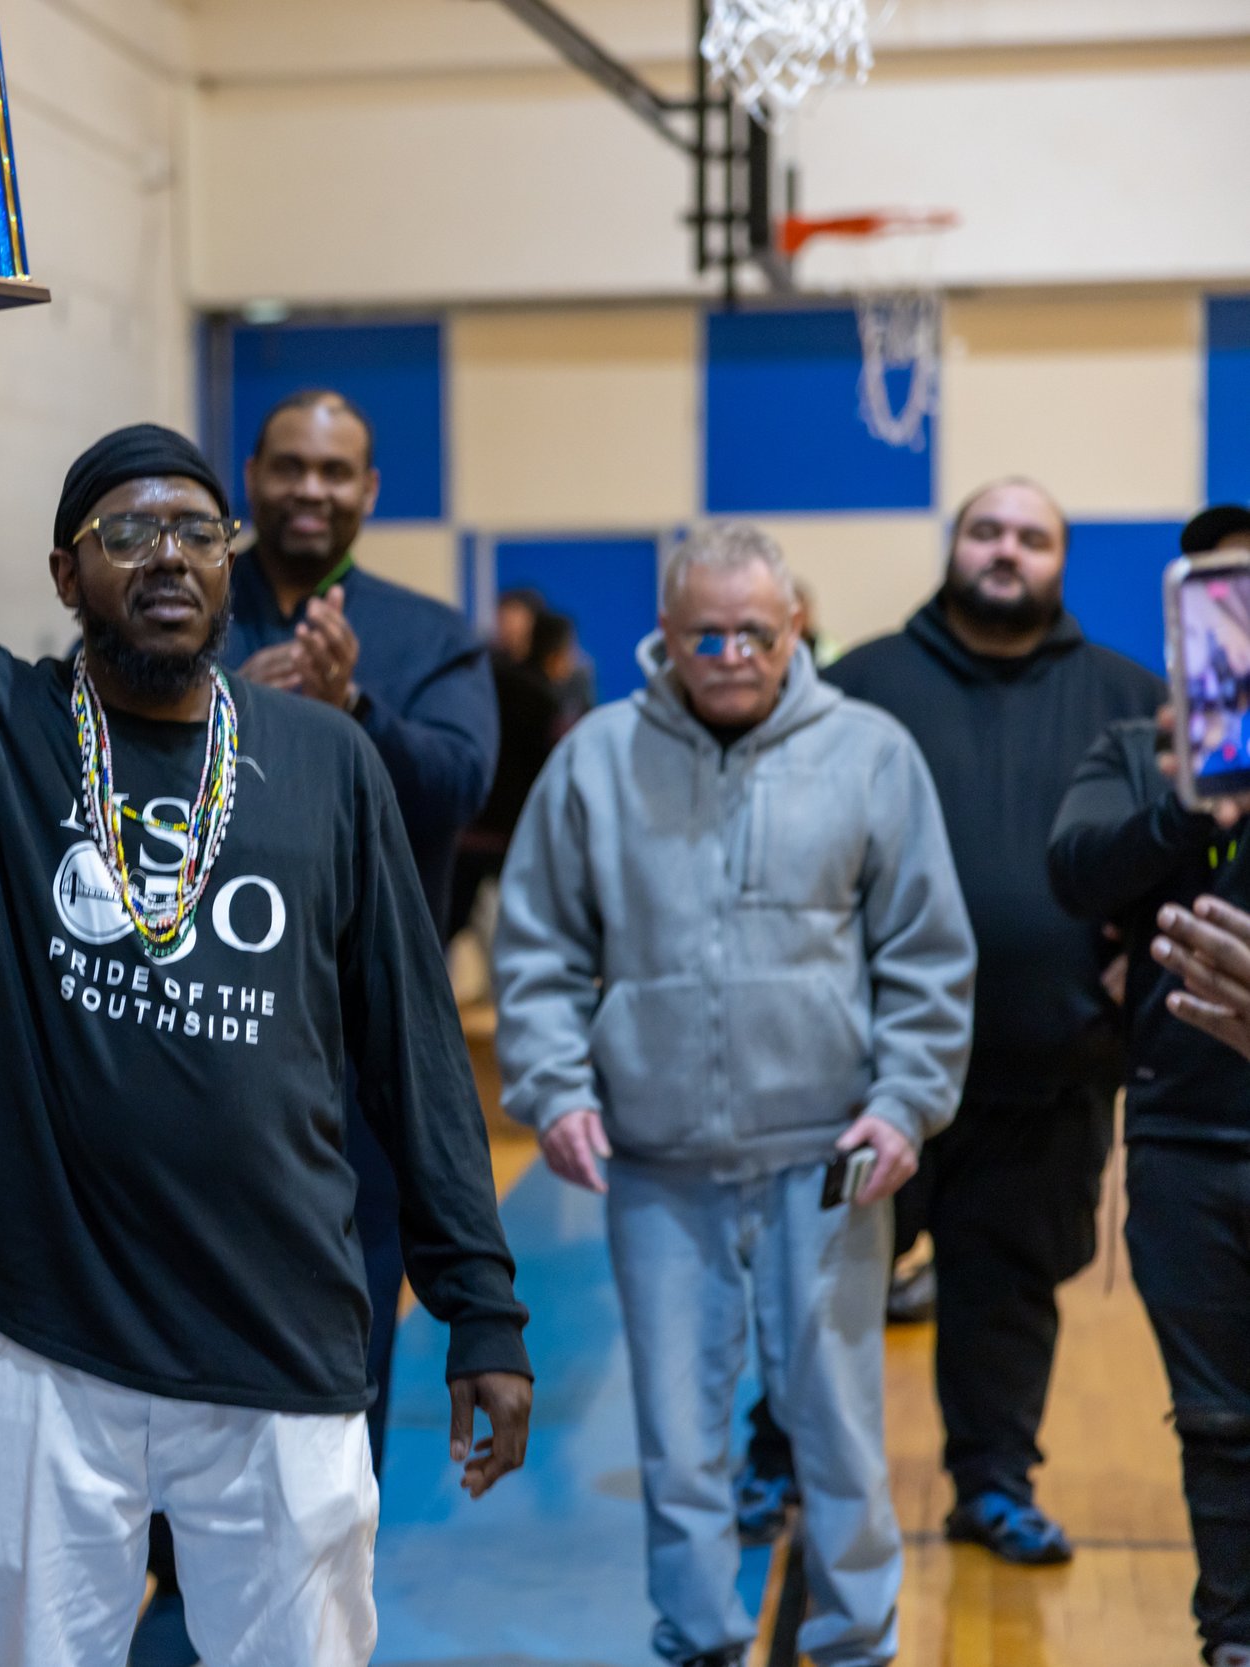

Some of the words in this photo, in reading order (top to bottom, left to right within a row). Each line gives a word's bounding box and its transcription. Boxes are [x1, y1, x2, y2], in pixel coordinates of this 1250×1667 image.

[49, 936, 150, 992] PRIDE
[164, 977, 204, 1006] OF
[218, 985, 275, 1016] THE
[60, 975, 260, 1044] SOUTHSIDE
